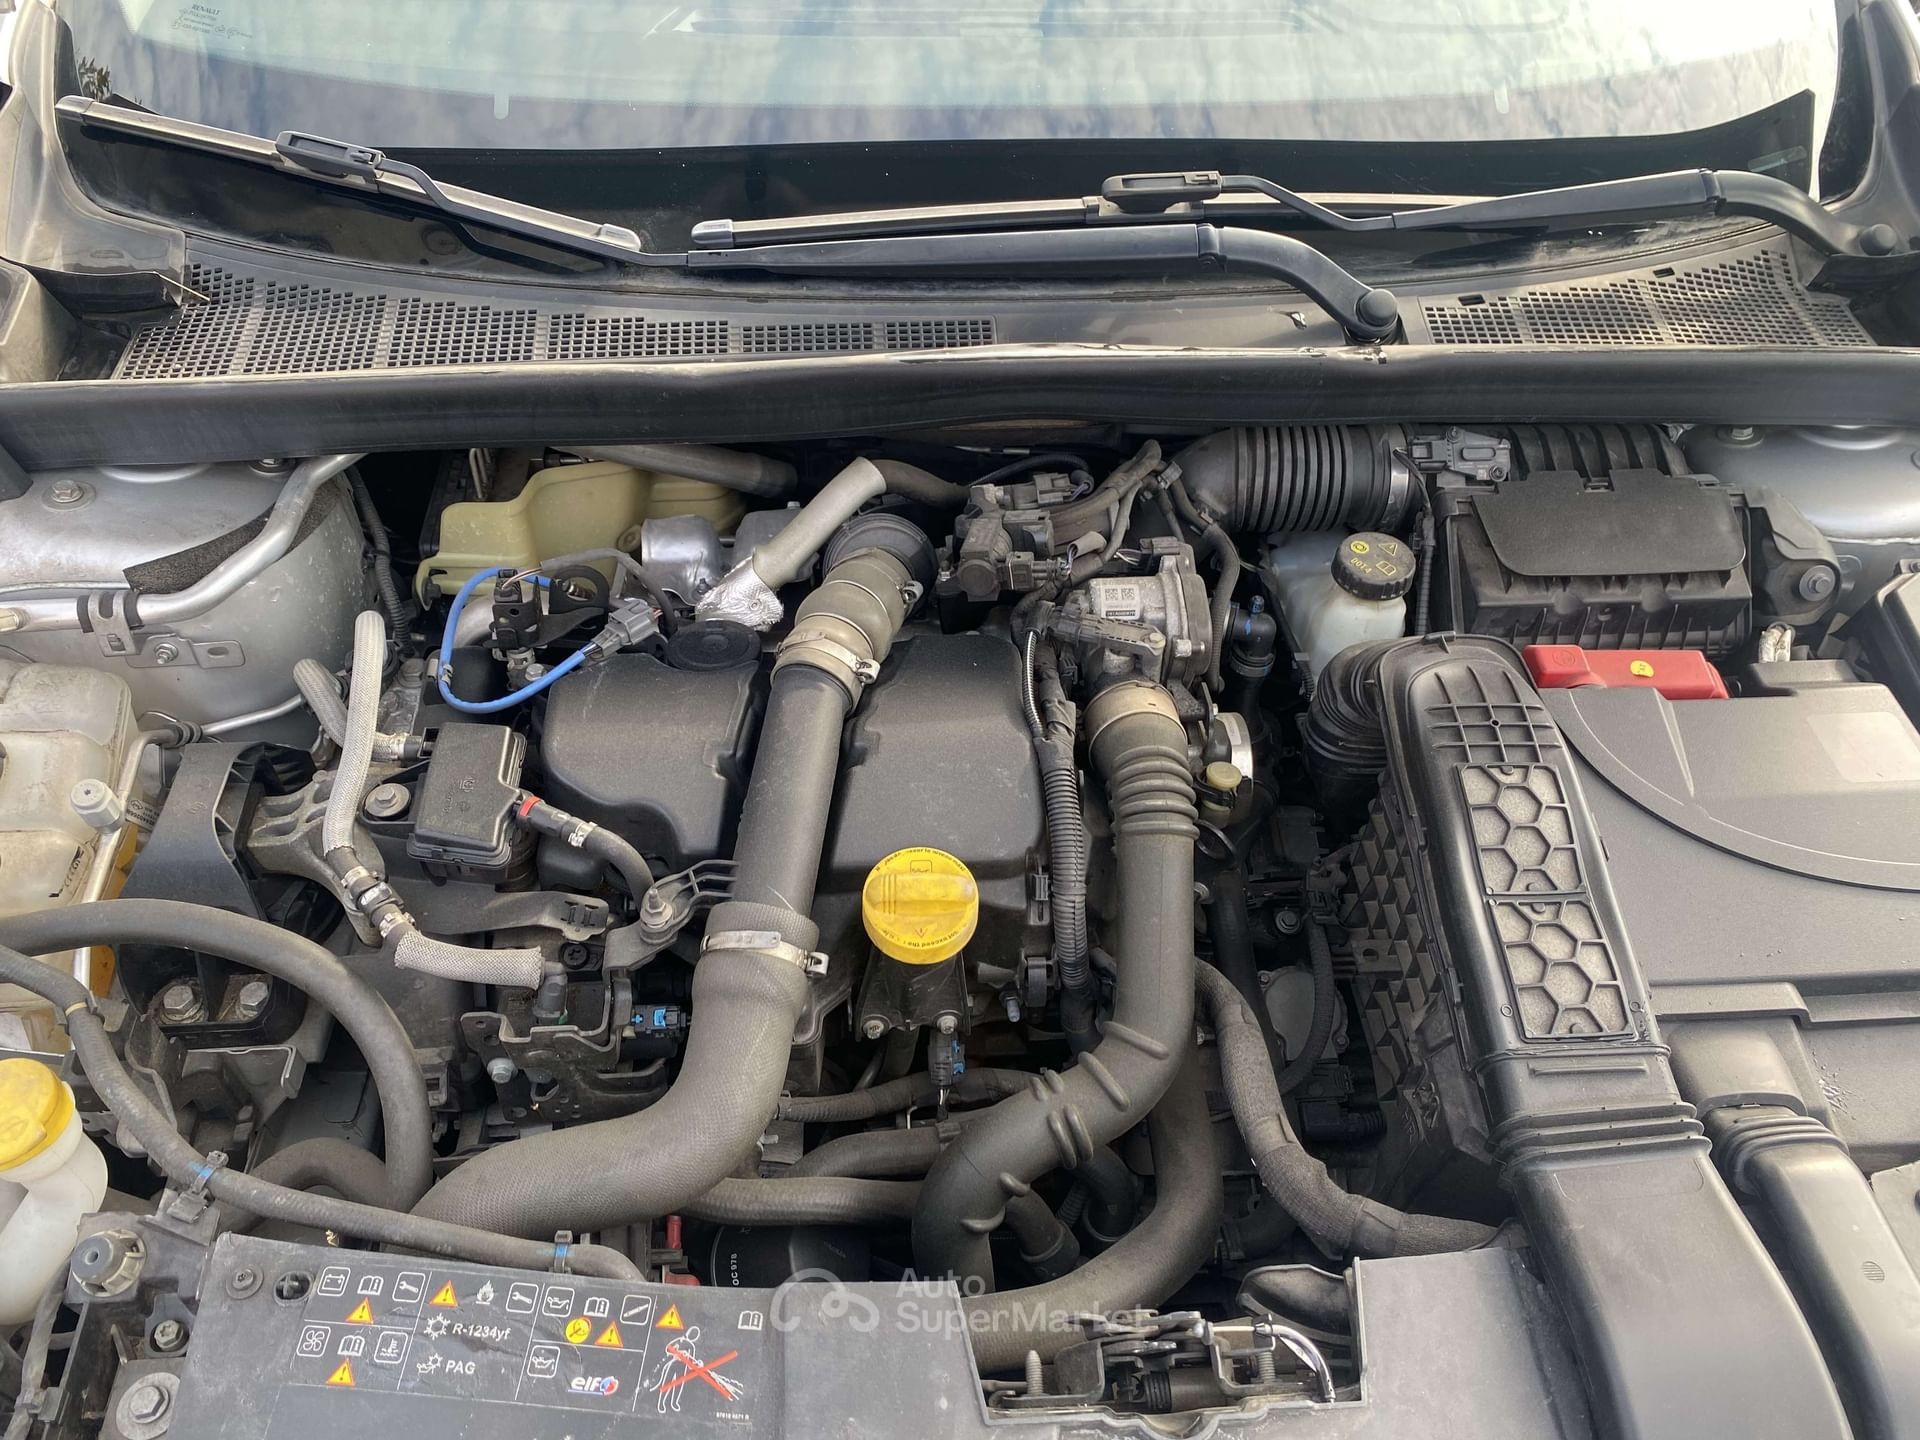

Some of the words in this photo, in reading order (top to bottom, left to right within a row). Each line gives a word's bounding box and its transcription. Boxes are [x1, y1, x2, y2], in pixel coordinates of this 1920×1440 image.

[452, 1323, 511, 1341] R-1234yf
[446, 1361, 476, 1375] PAG
[571, 1376, 602, 1392] elf
